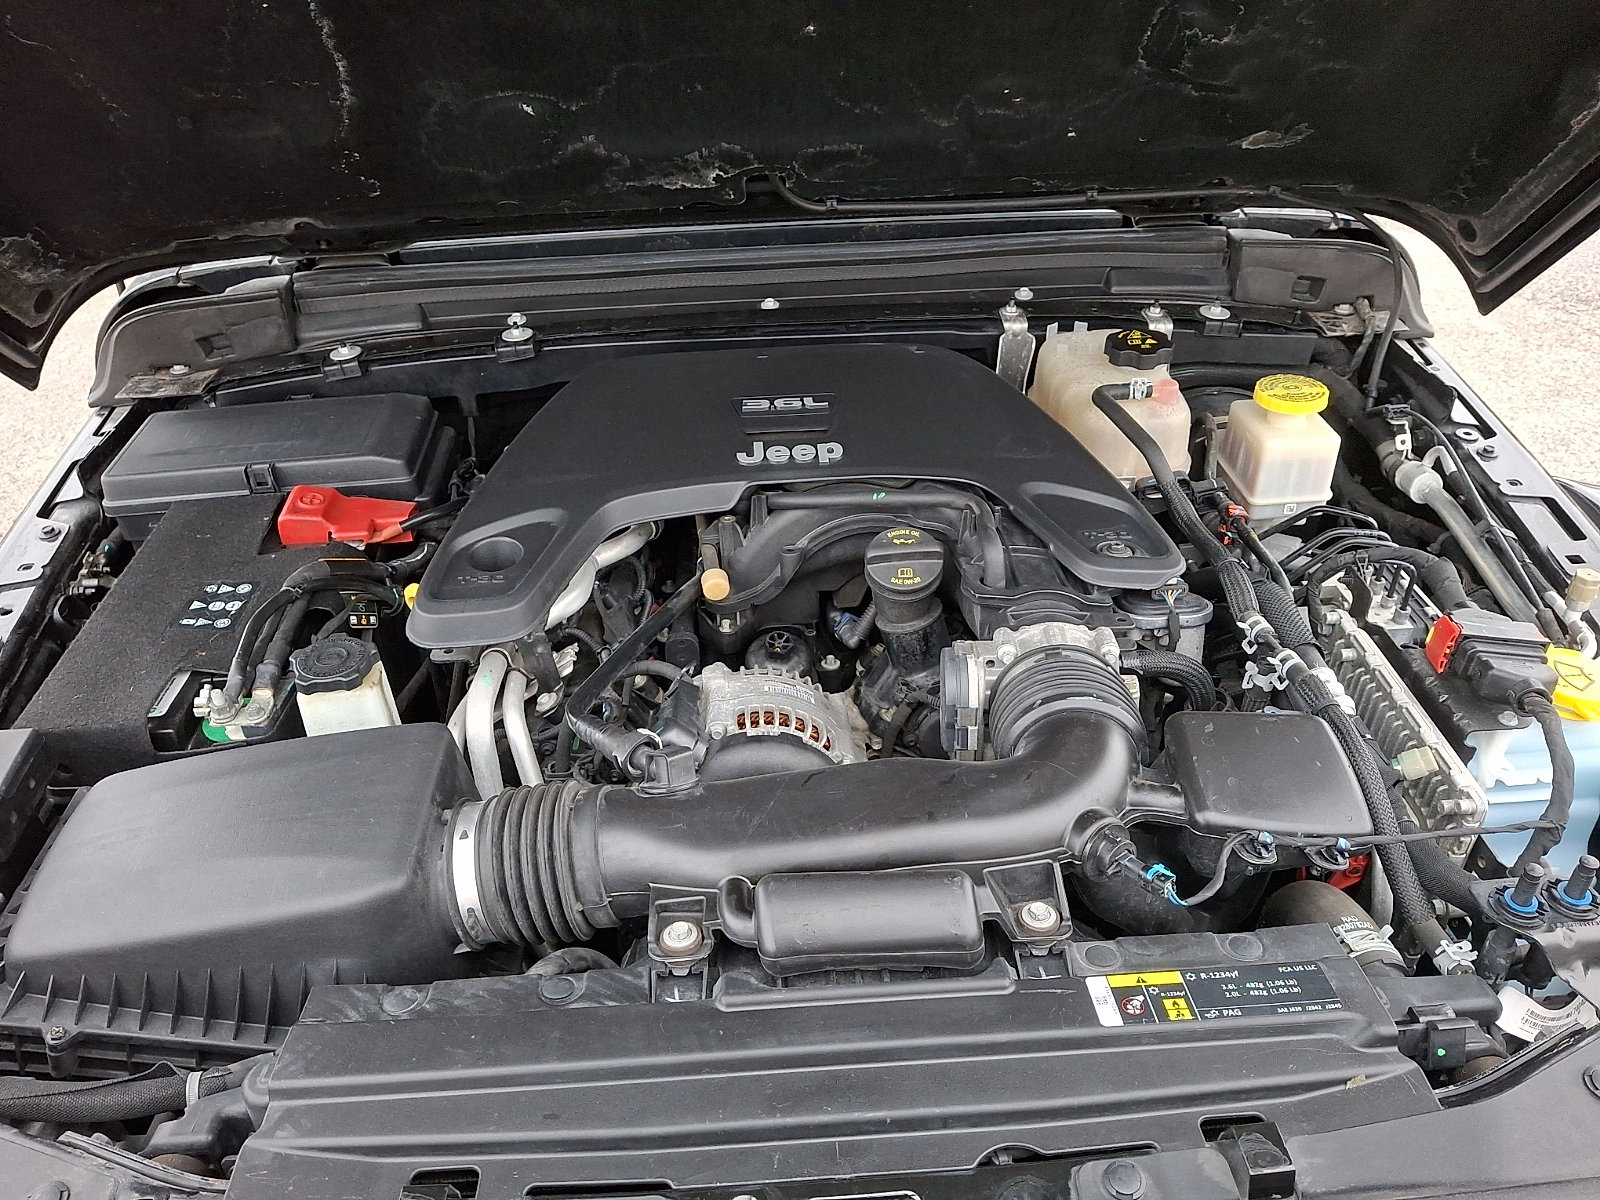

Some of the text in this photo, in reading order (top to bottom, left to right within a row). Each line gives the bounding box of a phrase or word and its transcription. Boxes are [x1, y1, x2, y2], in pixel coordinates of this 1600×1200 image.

[741, 396, 829, 412] 3.6L
[736, 441, 844, 466] Jeep
[886, 529, 910, 538] ENGINE
[890, 577, 903, 585] SAE
[1341, 915, 1359, 923] RAD
[1200, 970, 1239, 980] R-1234yf
[1266, 980, 1286, 988] (1.06
[1270, 988, 1290, 996] (1.06
[1290, 986, 1302, 994] Lb)
[1223, 1009, 1242, 1017] PAG
